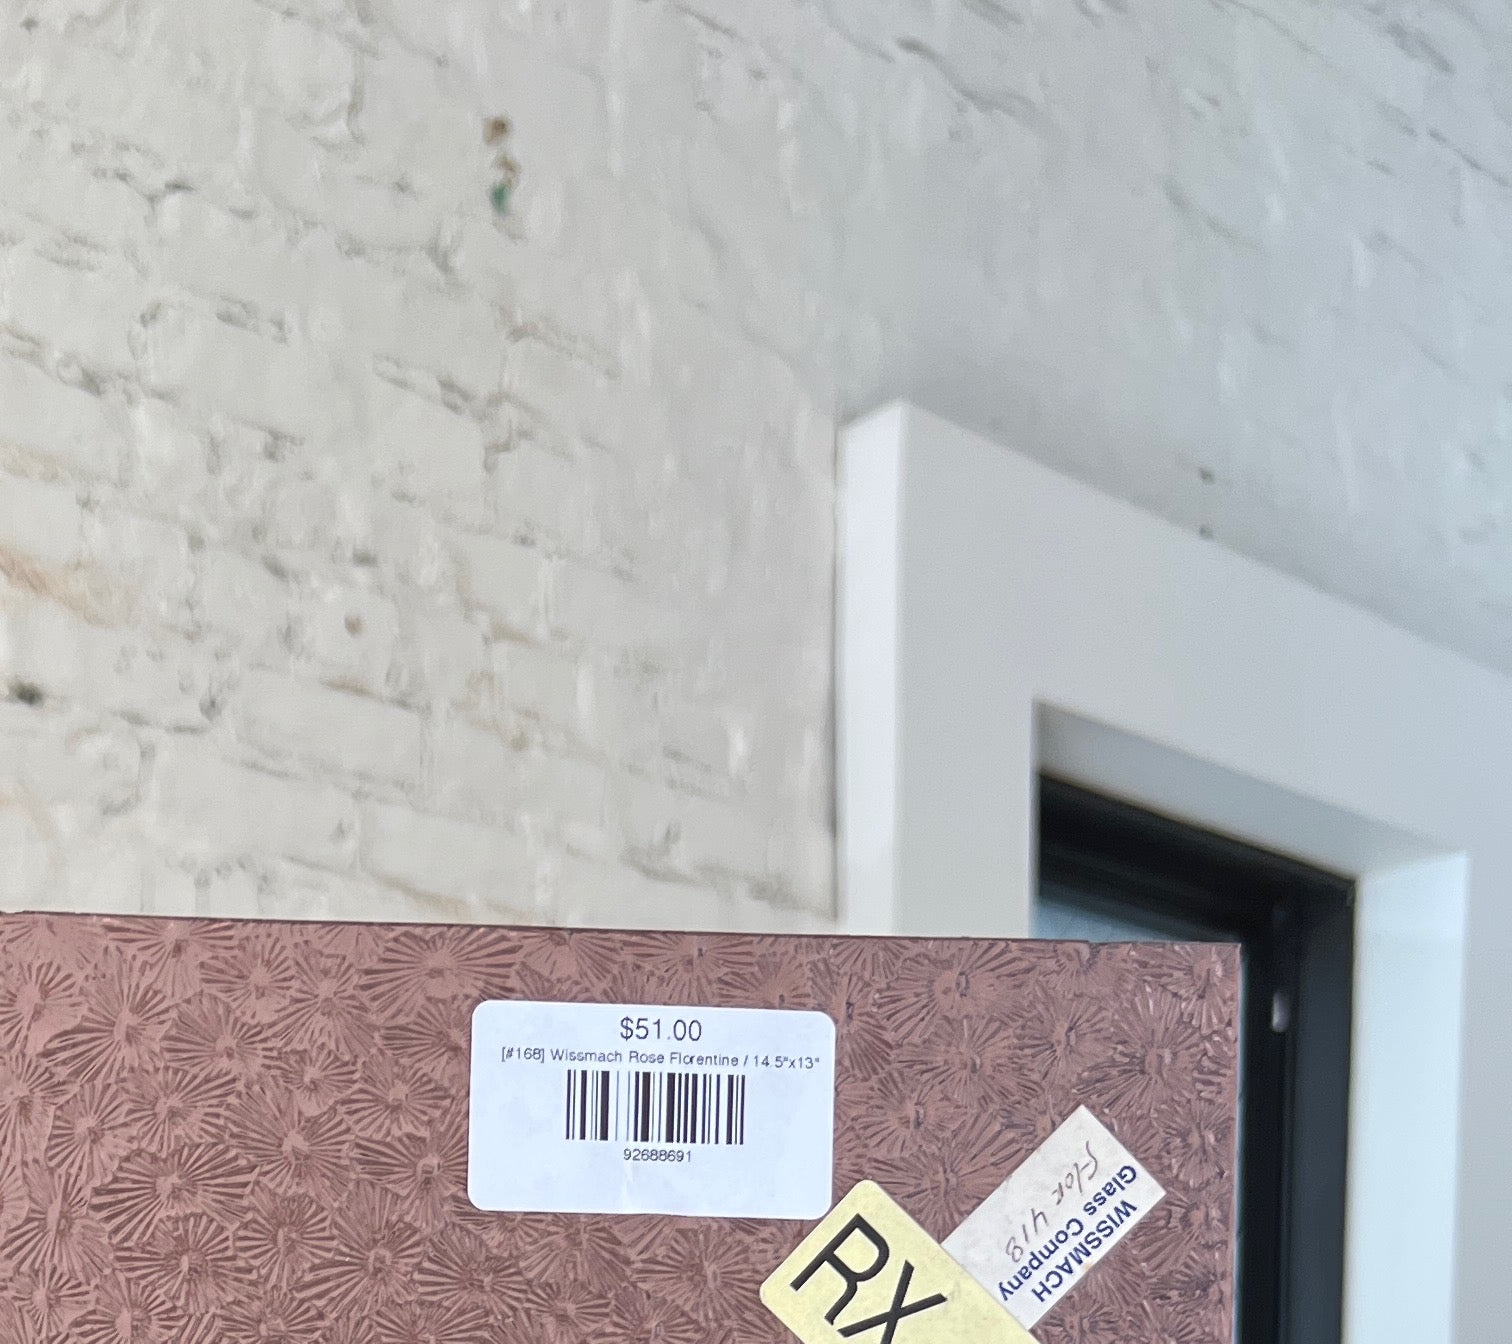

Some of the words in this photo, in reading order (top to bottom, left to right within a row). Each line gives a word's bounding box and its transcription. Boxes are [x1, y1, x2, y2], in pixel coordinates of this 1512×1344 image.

[620, 1016, 703, 1042] $51.00
[501, 1046, 546, 1064] [#168]
[550, 1050, 622, 1064] Wissmach
[629, 1050, 665, 1065] Rose
[670, 1052, 739, 1067] Florentine
[623, 1148, 692, 1163] 92688691
[1082, 1164, 1138, 1217] Glass
[998, 1217, 1085, 1302] Company
[1005, 1208, 1049, 1264] 418
[1031, 1199, 1138, 1303] WISSMACH
